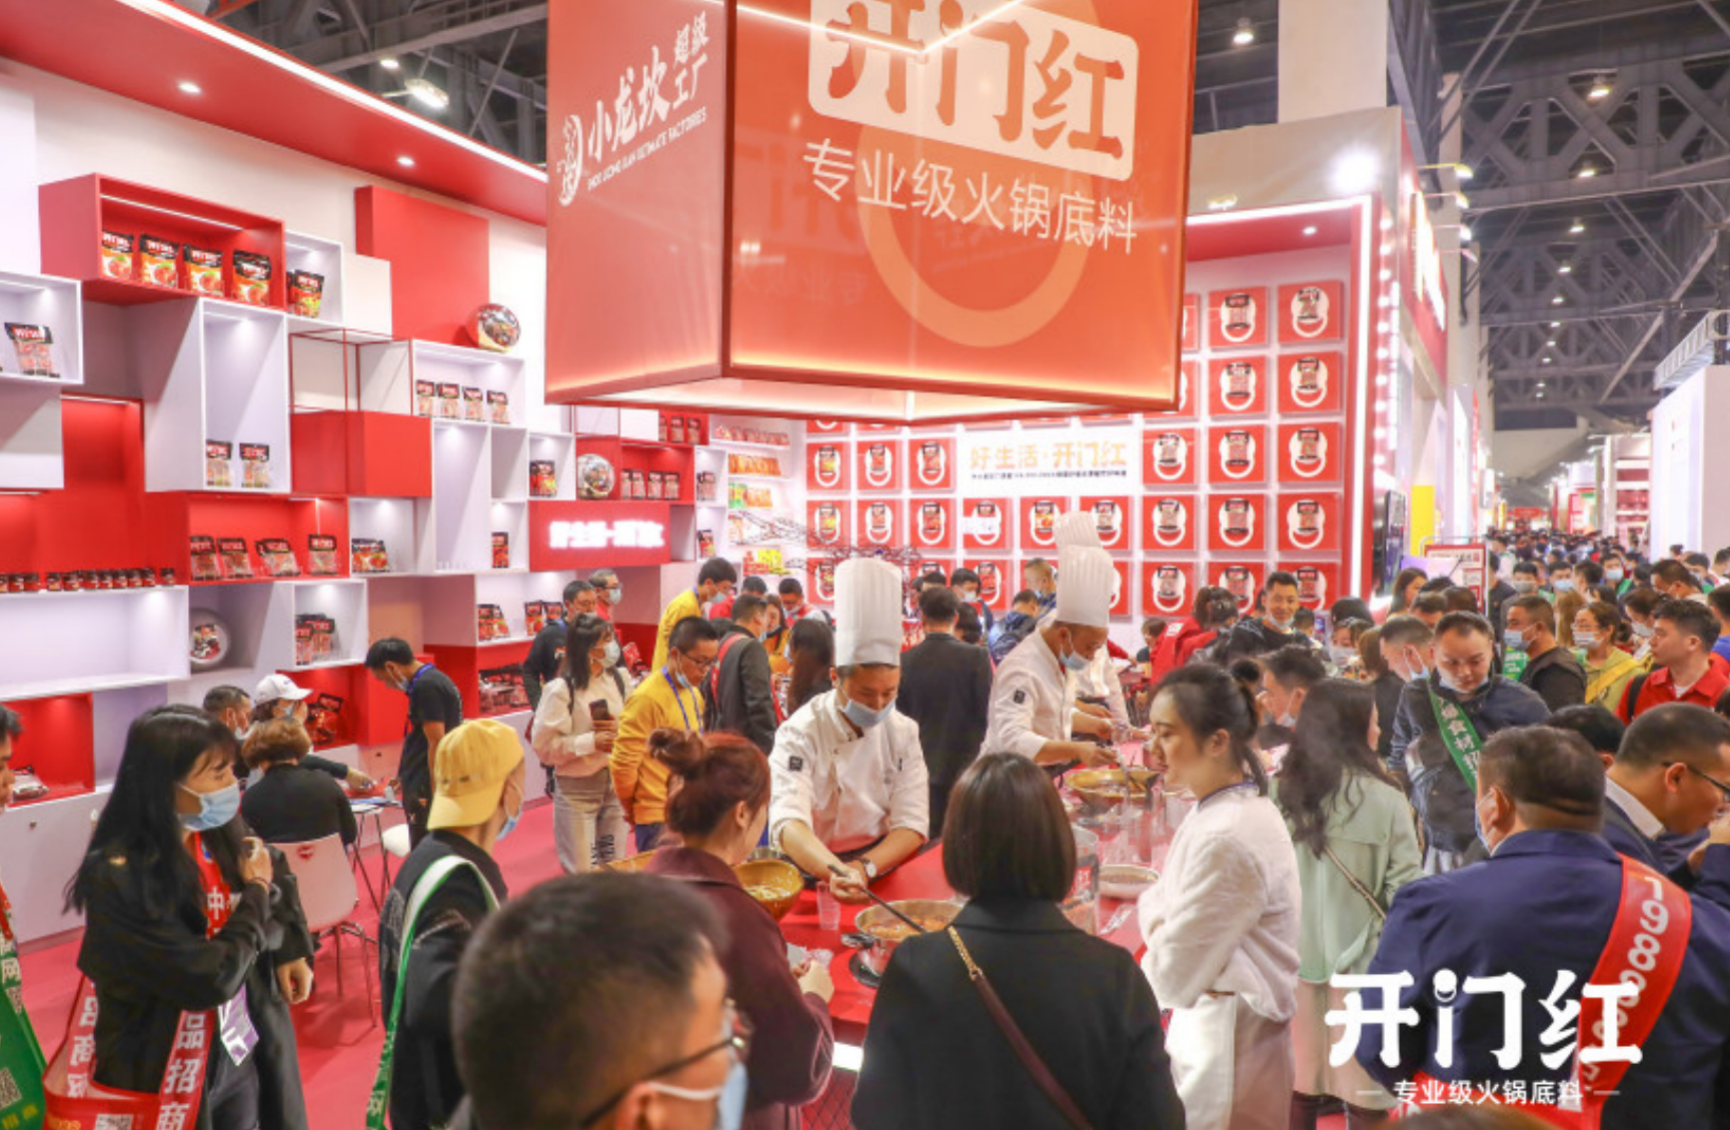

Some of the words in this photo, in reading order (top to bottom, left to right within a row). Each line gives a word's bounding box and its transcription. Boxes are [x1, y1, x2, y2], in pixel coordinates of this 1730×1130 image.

[587, 45, 671, 163] 小龙坎
[673, 53, 708, 109] 工厂
[826, 0, 1125, 160] 开门红
[803, 138, 1138, 255] 专业级火锅底料
[206, 886, 225, 921] 中
